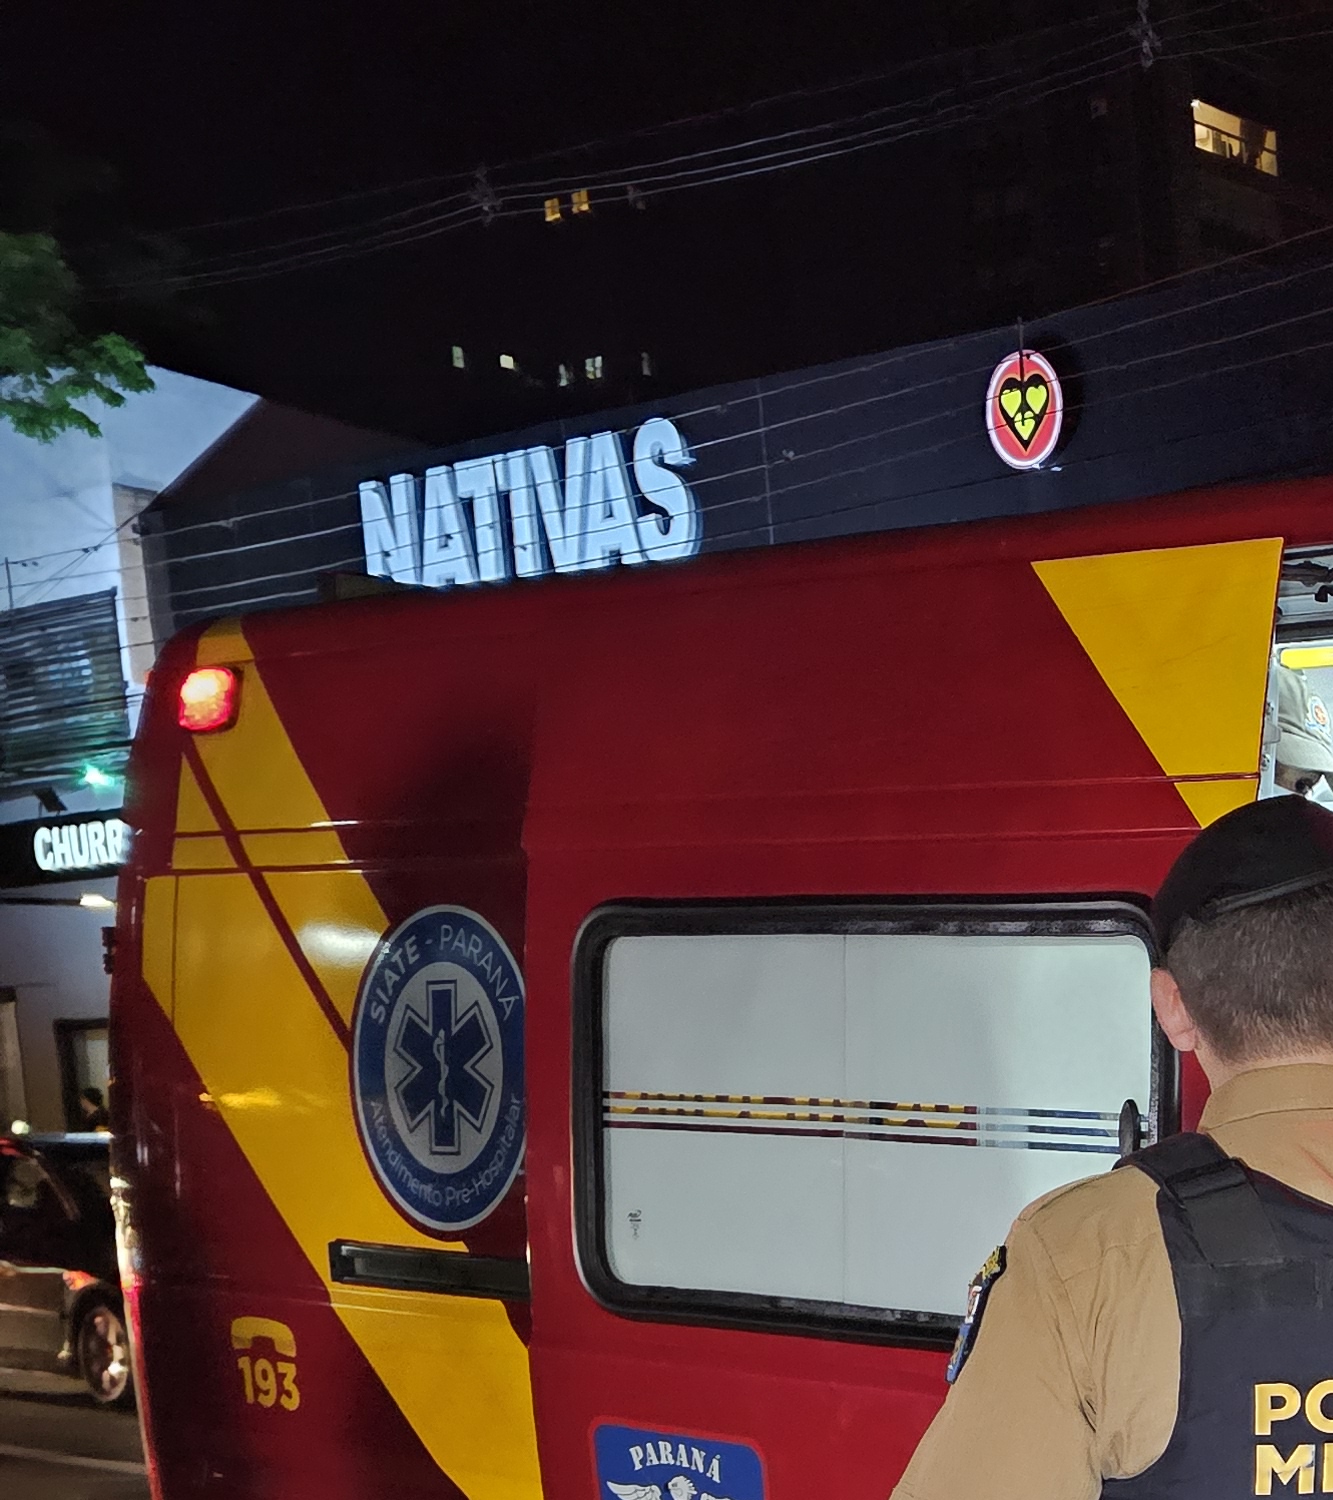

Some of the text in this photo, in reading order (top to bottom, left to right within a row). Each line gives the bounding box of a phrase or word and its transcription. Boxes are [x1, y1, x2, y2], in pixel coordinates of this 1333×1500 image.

[358, 417, 700, 587] NATIVAS
[370, 934, 421, 1026] SIATE
[439, 924, 521, 1021] PARANÁ
[370, 1101, 442, 1207] Atendimento
[237, 1356, 301, 1411] 193
[629, 1440, 722, 1483] PARANÁ
